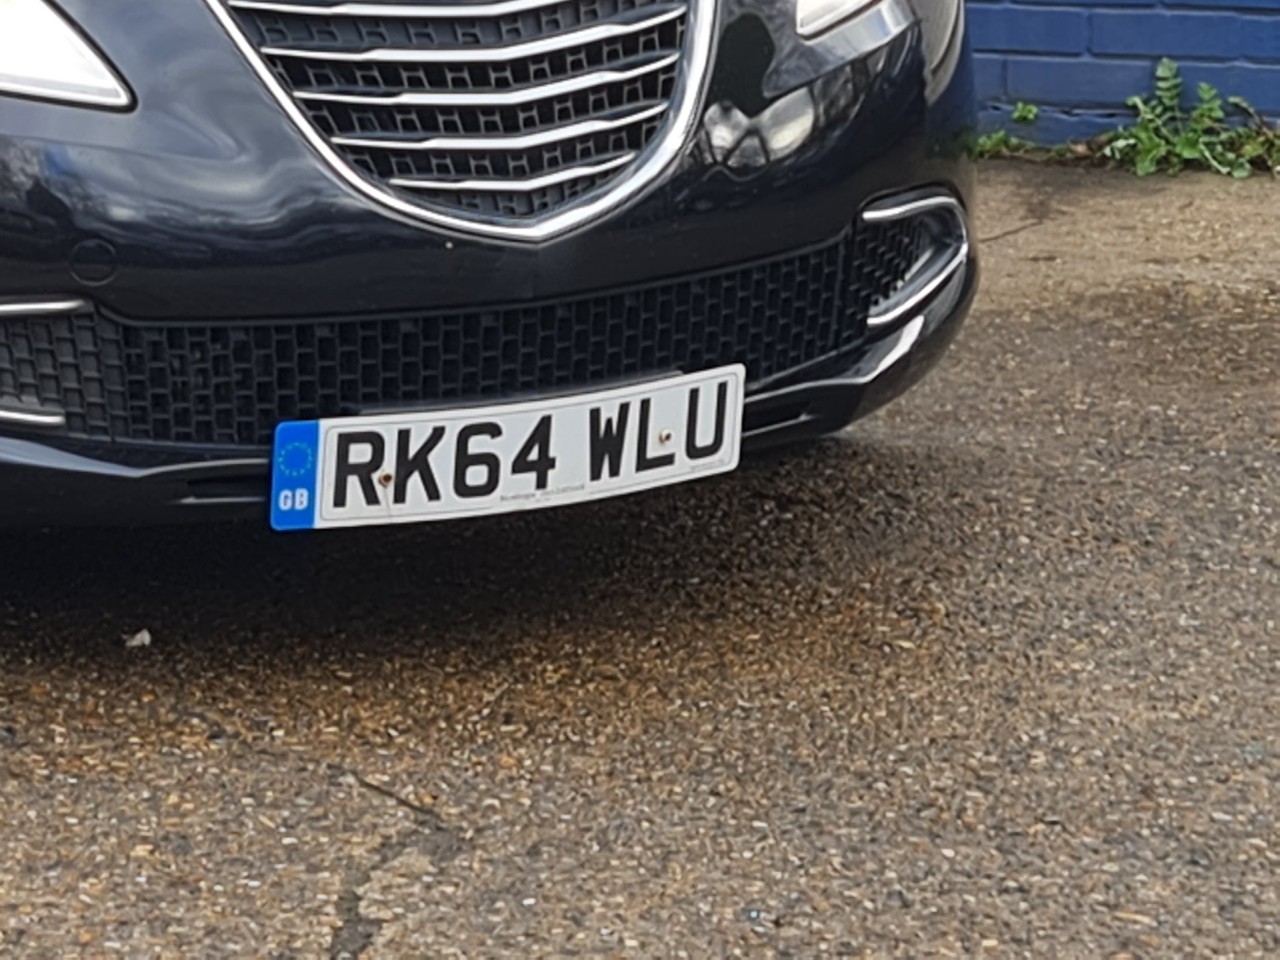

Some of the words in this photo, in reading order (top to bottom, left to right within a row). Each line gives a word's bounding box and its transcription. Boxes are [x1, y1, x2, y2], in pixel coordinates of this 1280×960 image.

[332, 414, 556, 509] RK64
[588, 381, 729, 482] WLU
[278, 488, 309, 511] GB
